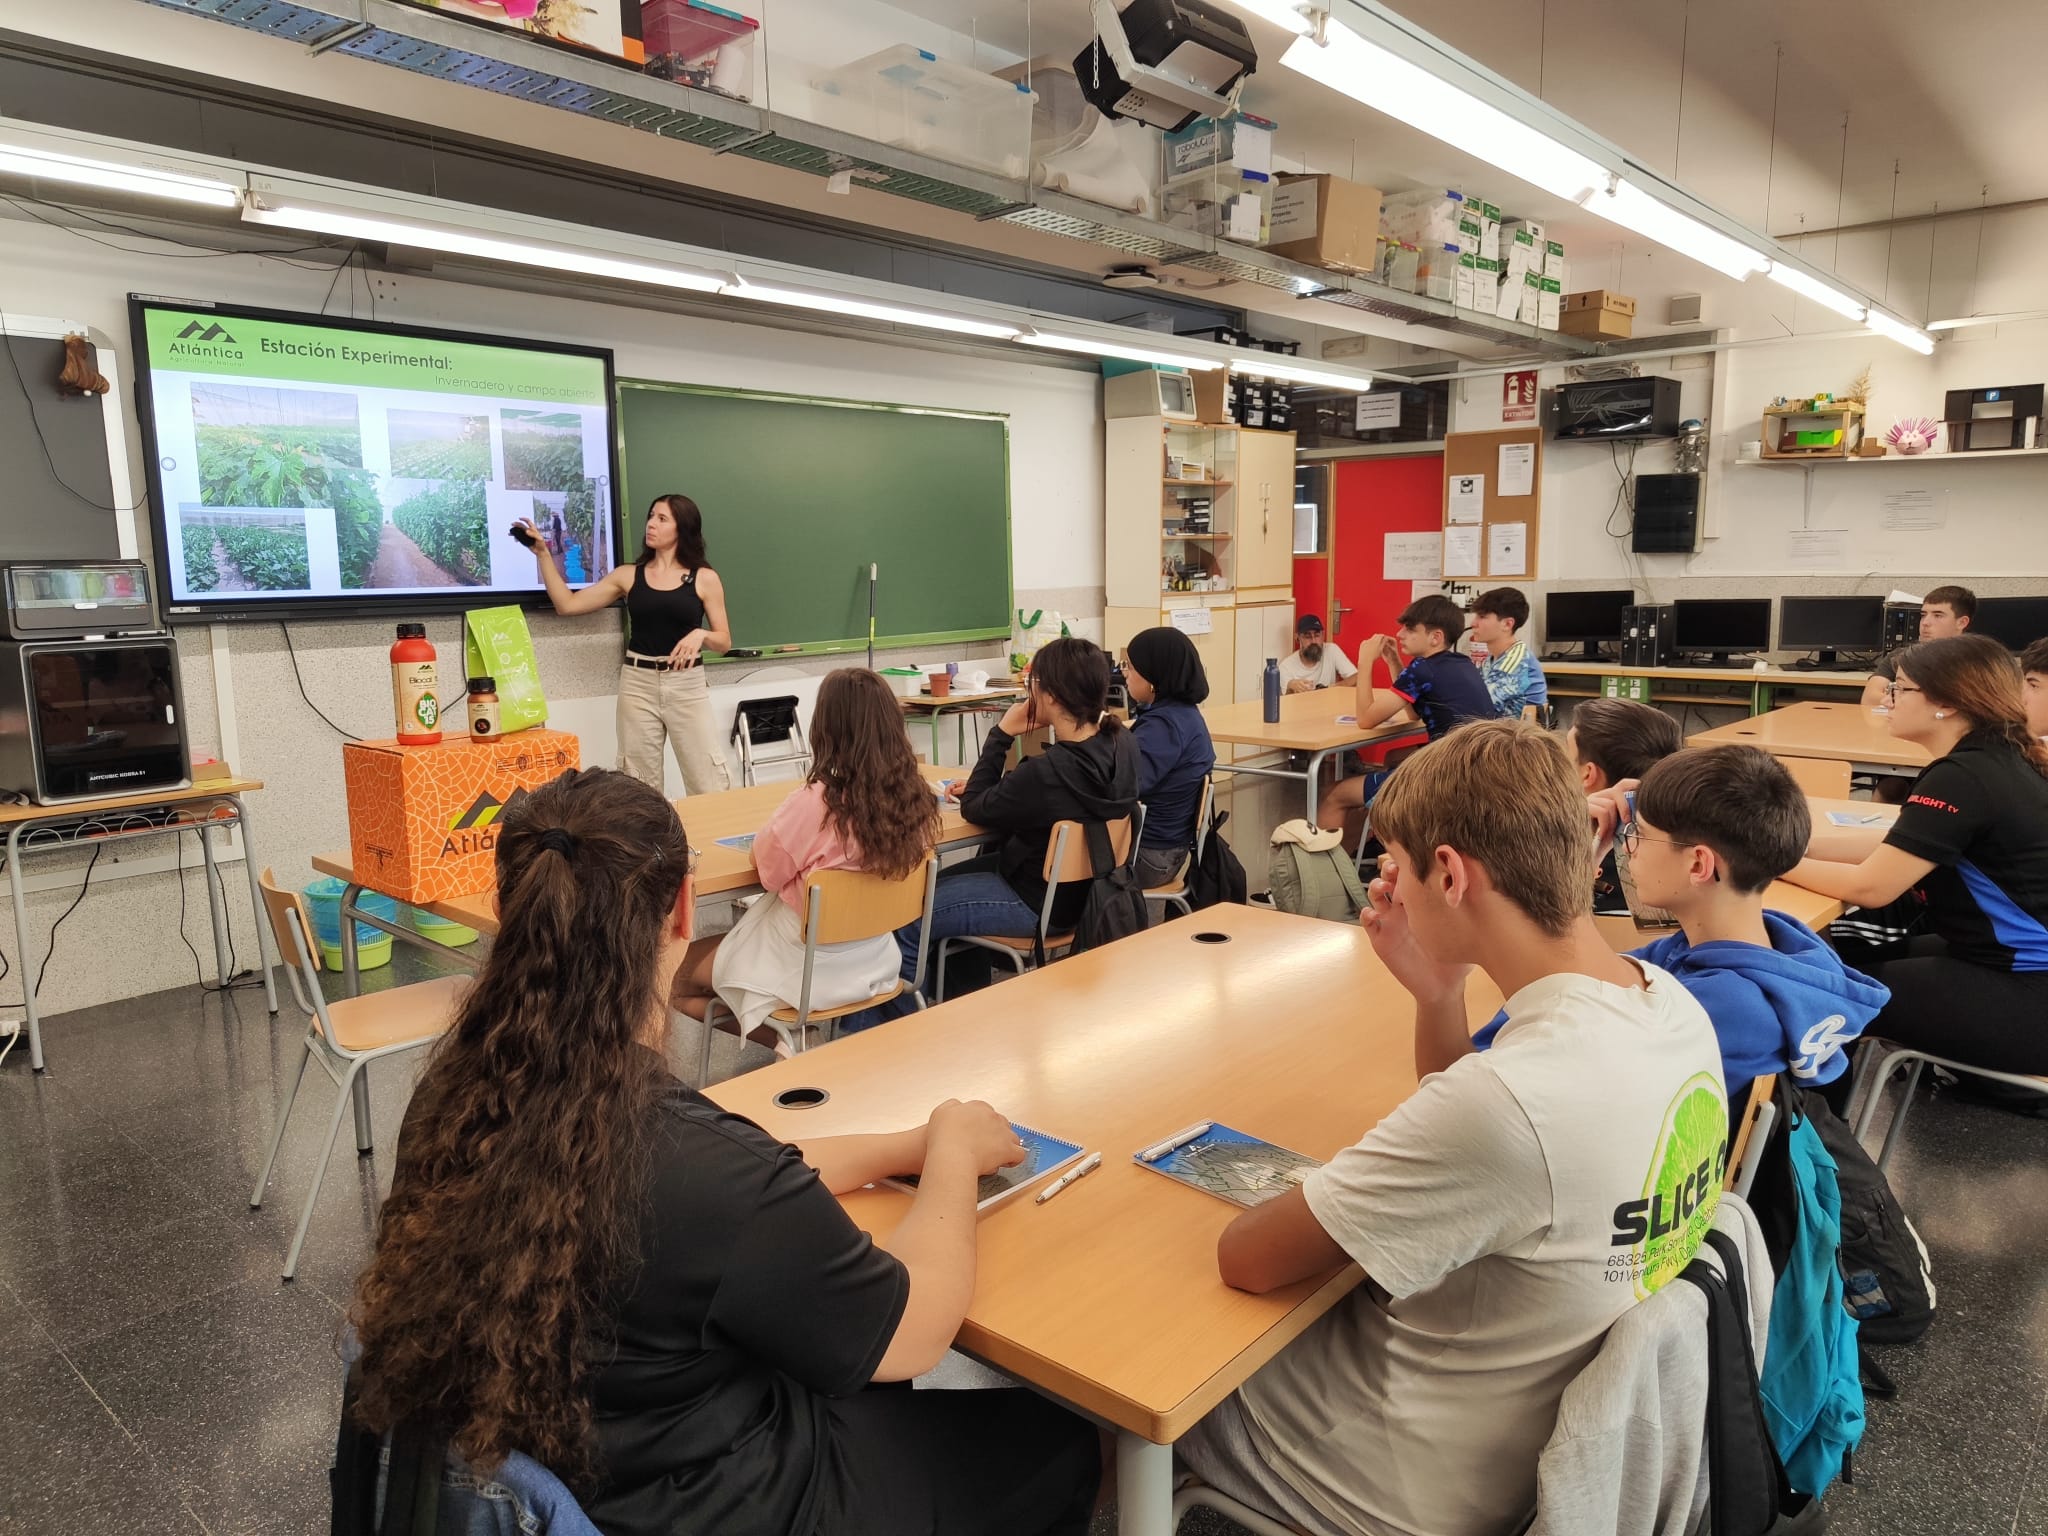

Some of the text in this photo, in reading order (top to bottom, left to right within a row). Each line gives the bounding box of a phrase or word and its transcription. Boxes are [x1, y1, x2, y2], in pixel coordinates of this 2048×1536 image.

[168, 342, 244, 360] Atlántica
[260, 338, 453, 371] Estación Experimental:
[435, 375, 597, 400] Invernadero y campo abierto
[1503, 410, 1535, 418] EXTINTOR
[418, 706, 437, 718] CAT
[419, 698, 437, 709] BIO
[1947, 804, 1960, 814] tv
[440, 828, 495, 858] Atlá
[1611, 1157, 1710, 1247] SLICE
[1606, 1250, 1648, 1268] 68325
[1648, 1243, 1667, 1259] Park
[1603, 1269, 1624, 1283] 101
[1625, 1262, 1660, 1281] Ventura
